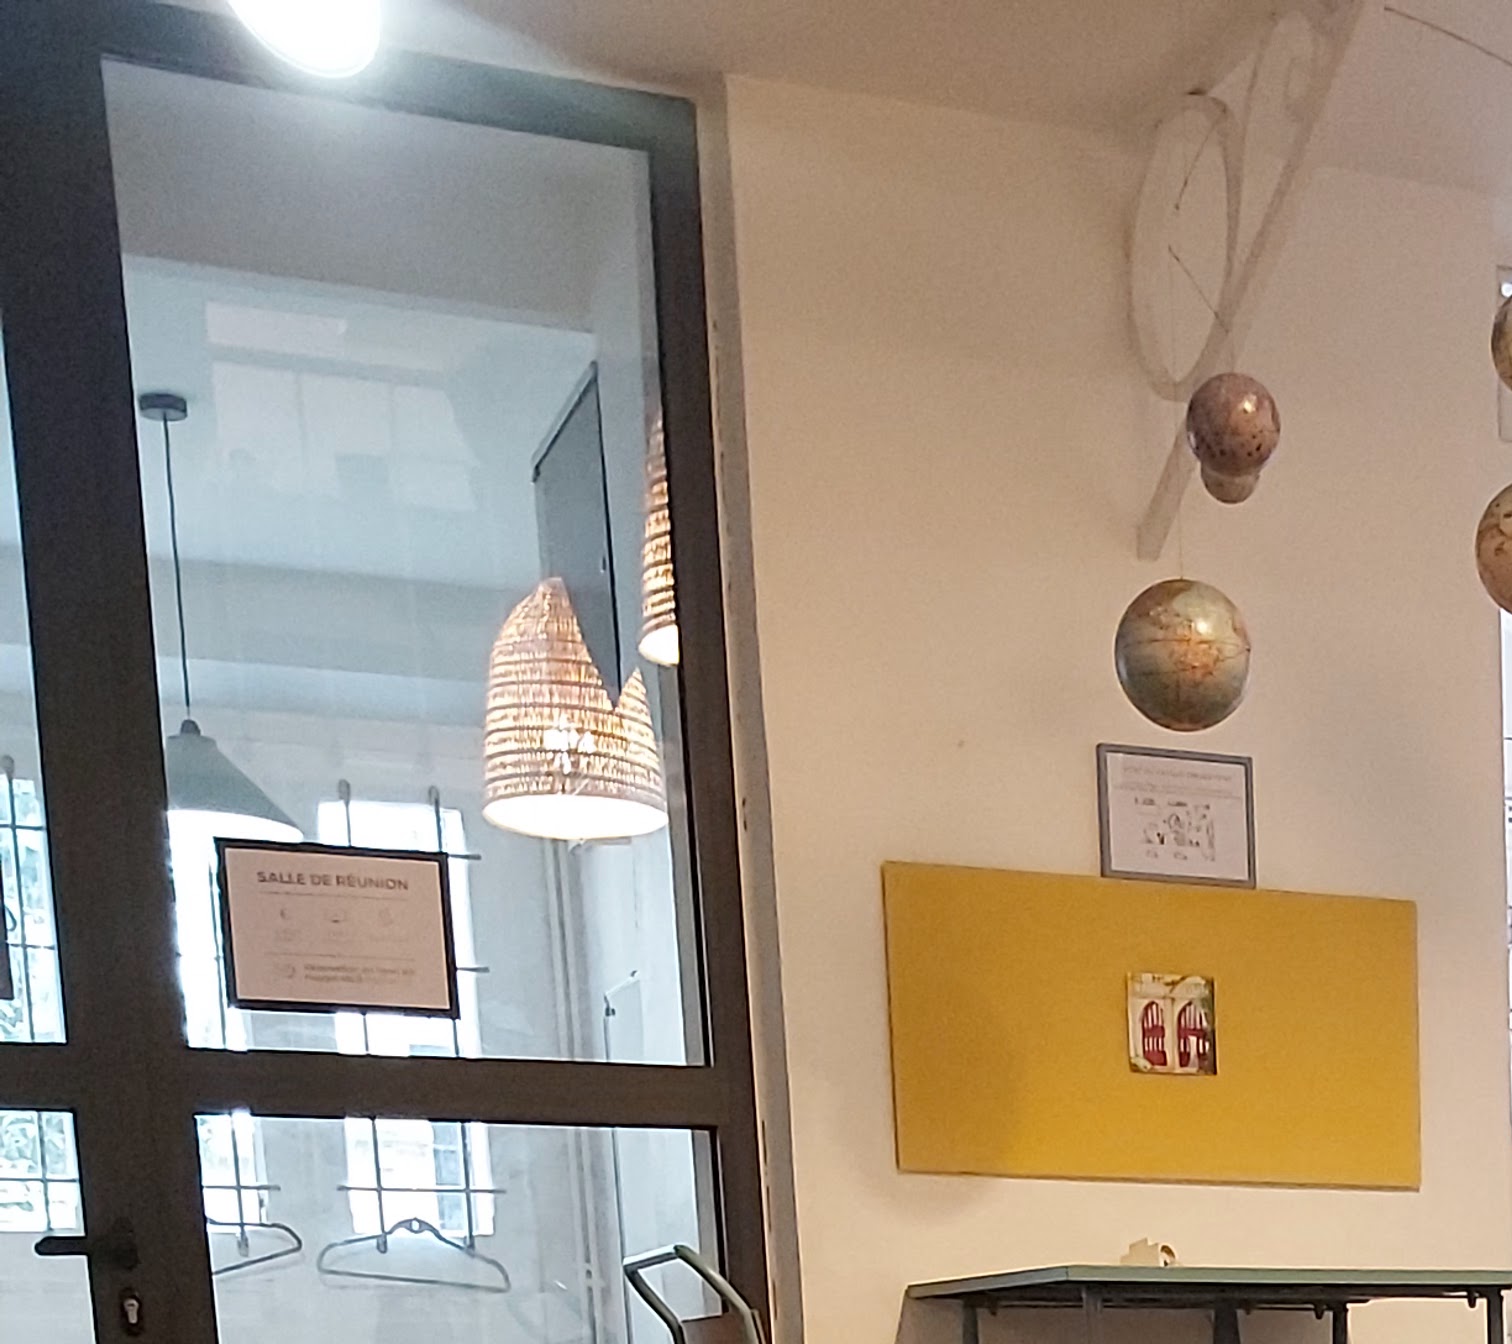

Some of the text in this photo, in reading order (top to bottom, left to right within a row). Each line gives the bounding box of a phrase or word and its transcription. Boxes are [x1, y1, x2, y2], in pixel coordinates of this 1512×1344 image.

[256, 871, 409, 890] SALLE DE RÉUNION
